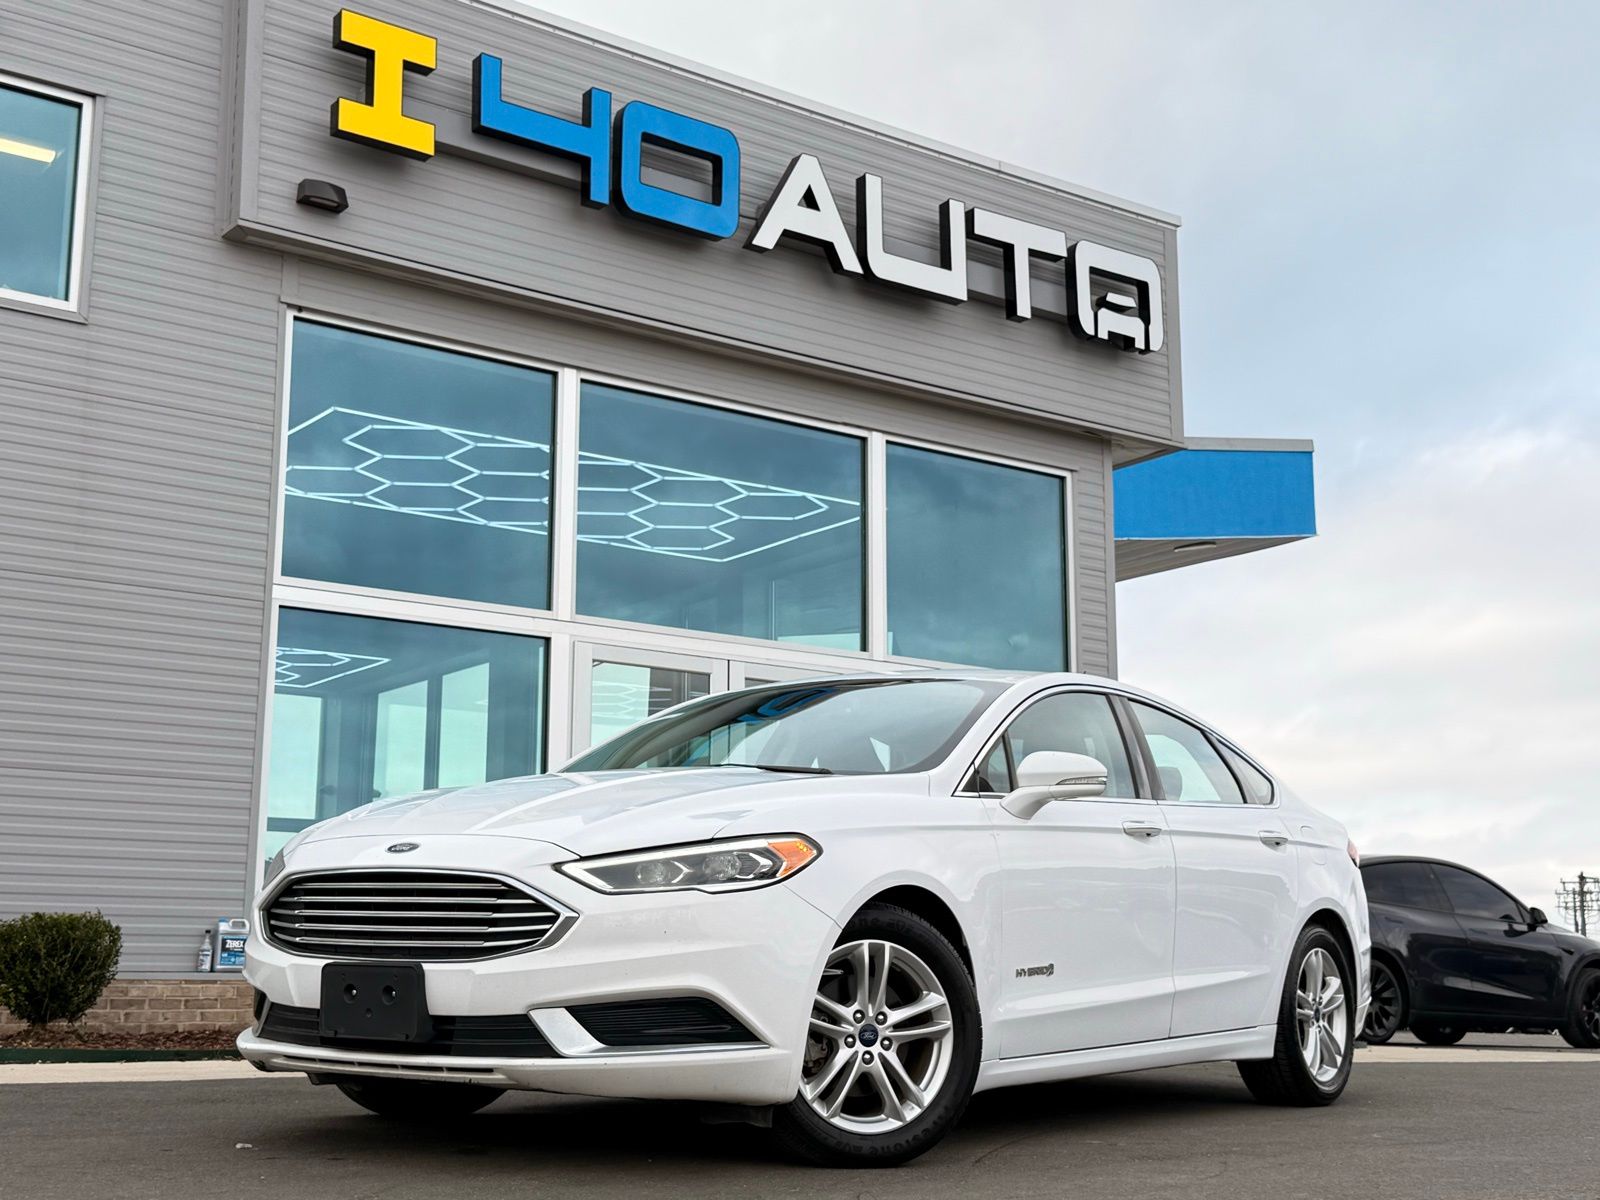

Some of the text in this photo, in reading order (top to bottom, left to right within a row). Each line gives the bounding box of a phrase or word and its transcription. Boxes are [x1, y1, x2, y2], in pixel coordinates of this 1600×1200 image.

[331, 8, 1164, 355] I 40 AUTO
[225, 940, 244, 948] ZEREX
